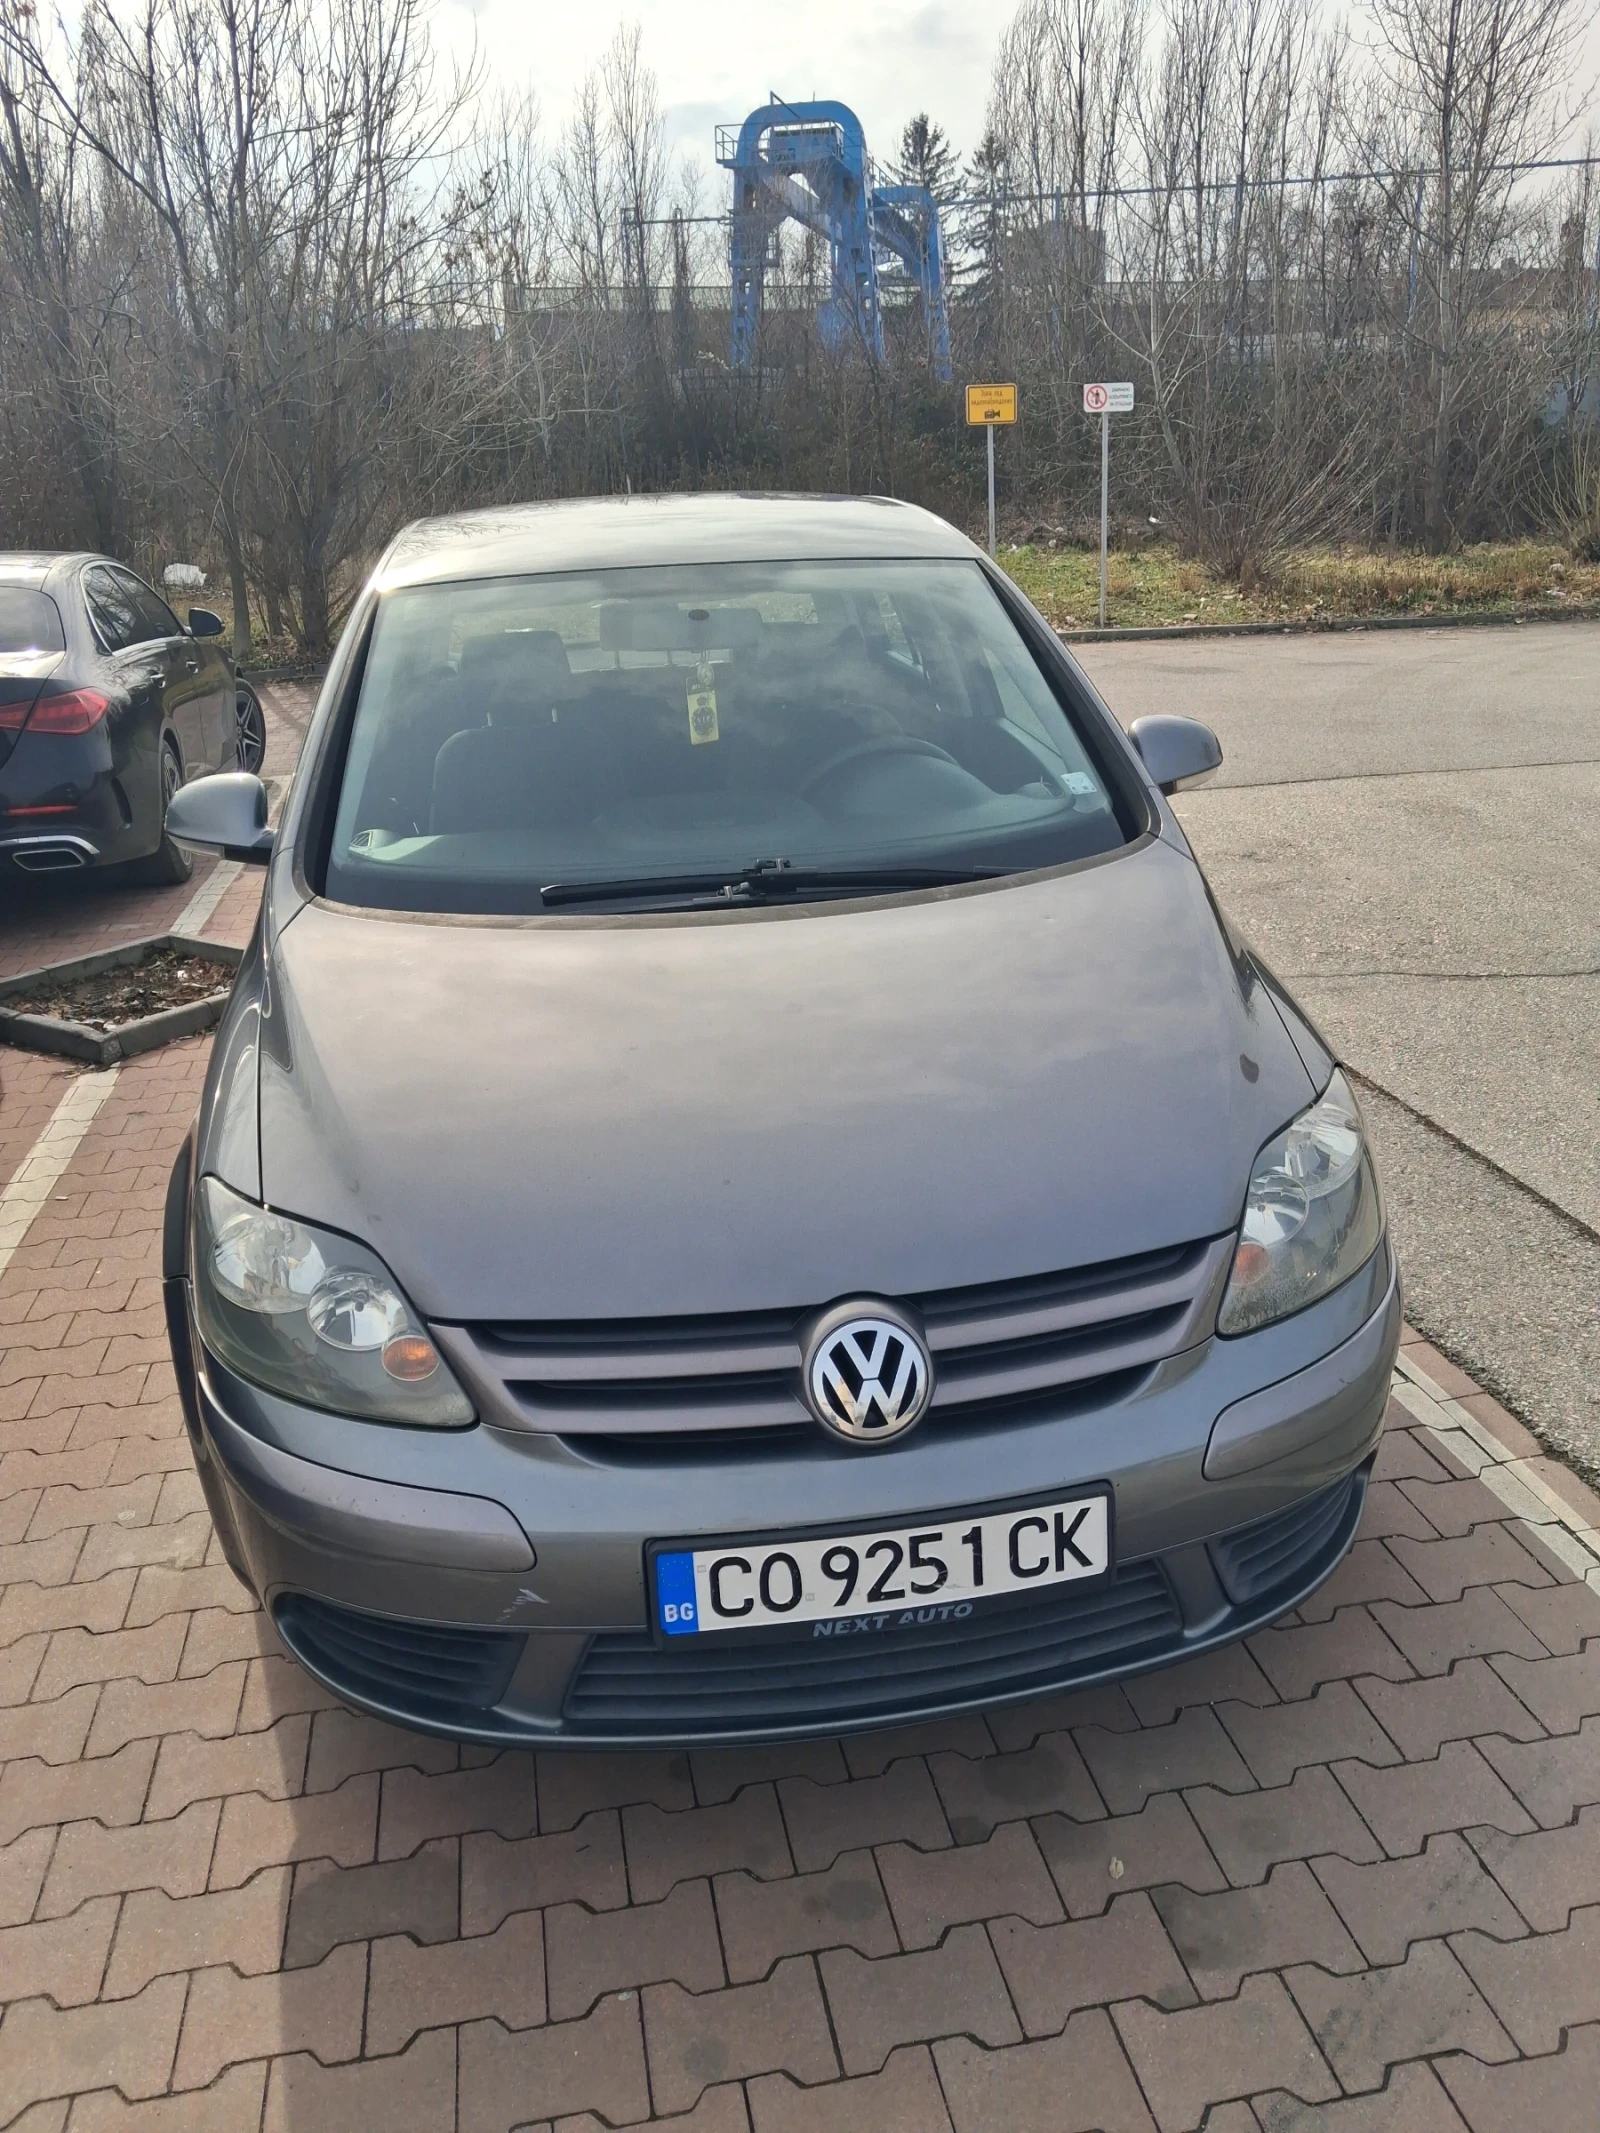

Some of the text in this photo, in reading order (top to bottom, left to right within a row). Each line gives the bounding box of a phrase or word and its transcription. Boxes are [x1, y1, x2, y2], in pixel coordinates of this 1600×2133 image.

[820, 1525, 984, 1607] 9251
[1008, 1507, 1095, 1579] CK
[664, 1602, 694, 1623] BG
[813, 1602, 973, 1637] NEXT AUTO
